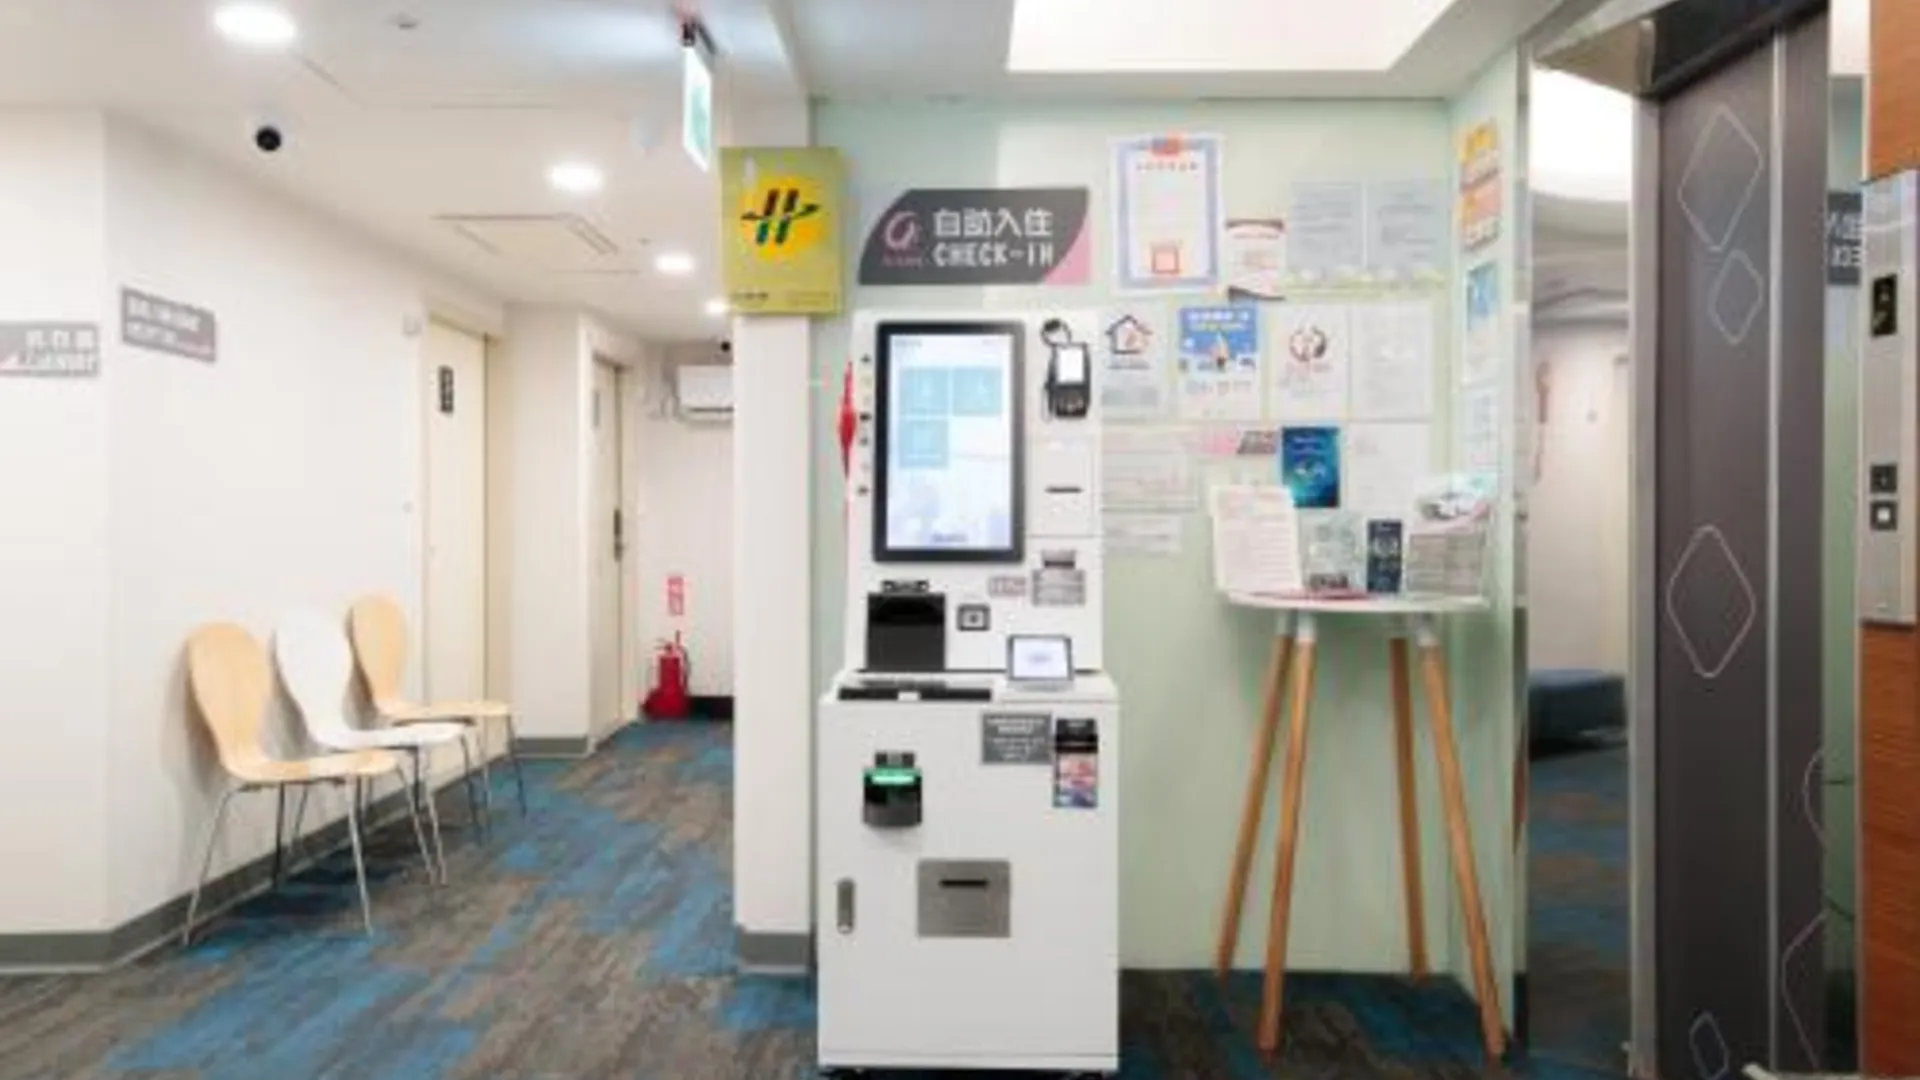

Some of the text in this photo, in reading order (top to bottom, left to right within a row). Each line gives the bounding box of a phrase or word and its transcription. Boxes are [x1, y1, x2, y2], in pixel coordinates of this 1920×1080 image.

[932, 207, 1054, 238] 自助入住
[932, 242, 1055, 268] CHECK-IN
